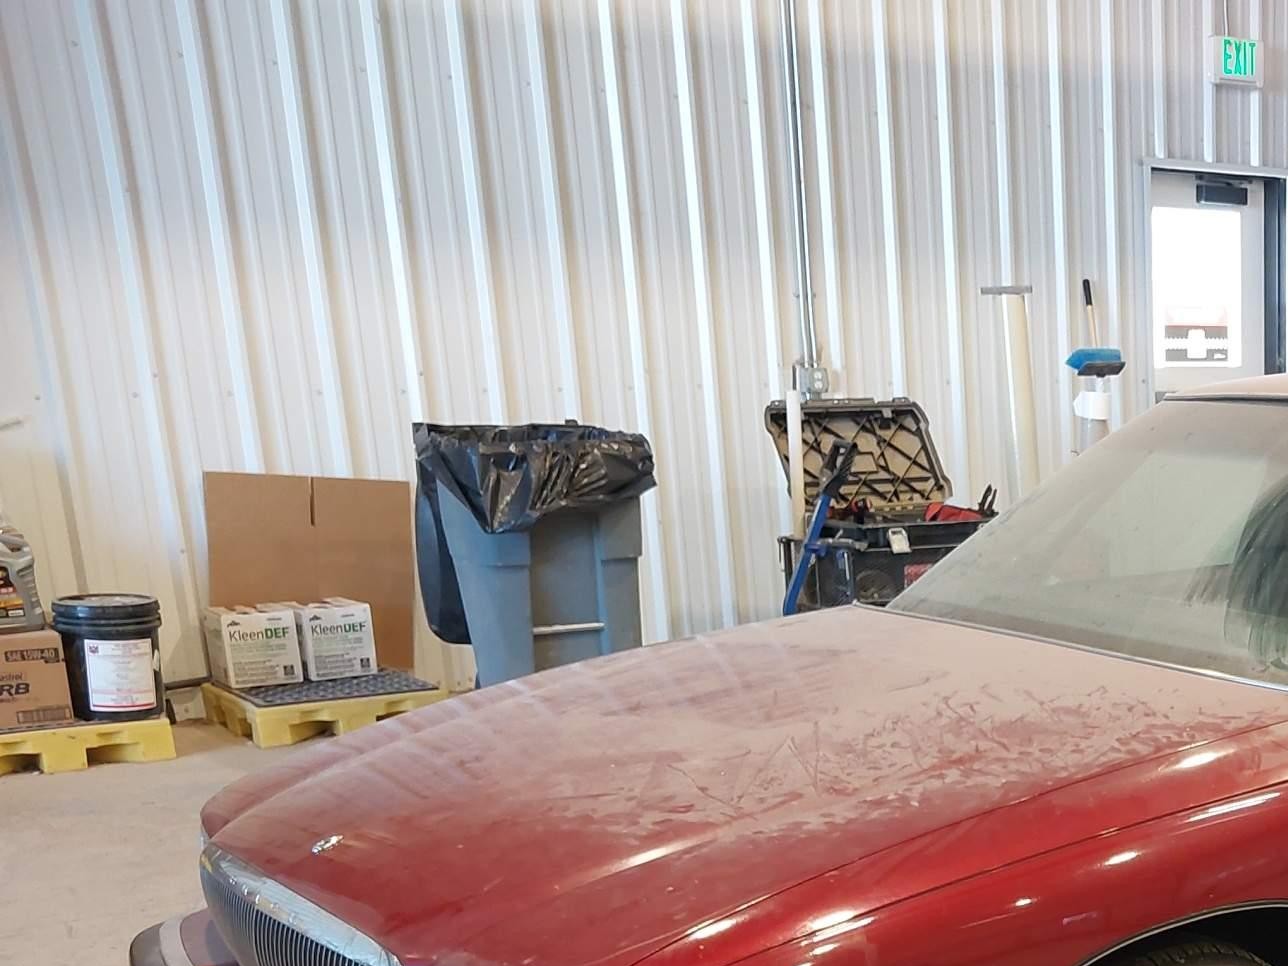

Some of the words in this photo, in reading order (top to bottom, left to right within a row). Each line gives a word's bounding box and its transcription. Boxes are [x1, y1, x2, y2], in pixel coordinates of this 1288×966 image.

[1223, 38, 1257, 76] EXIT
[228, 626, 289, 642] KleenDEF
[310, 621, 367, 636] KleenDEF
